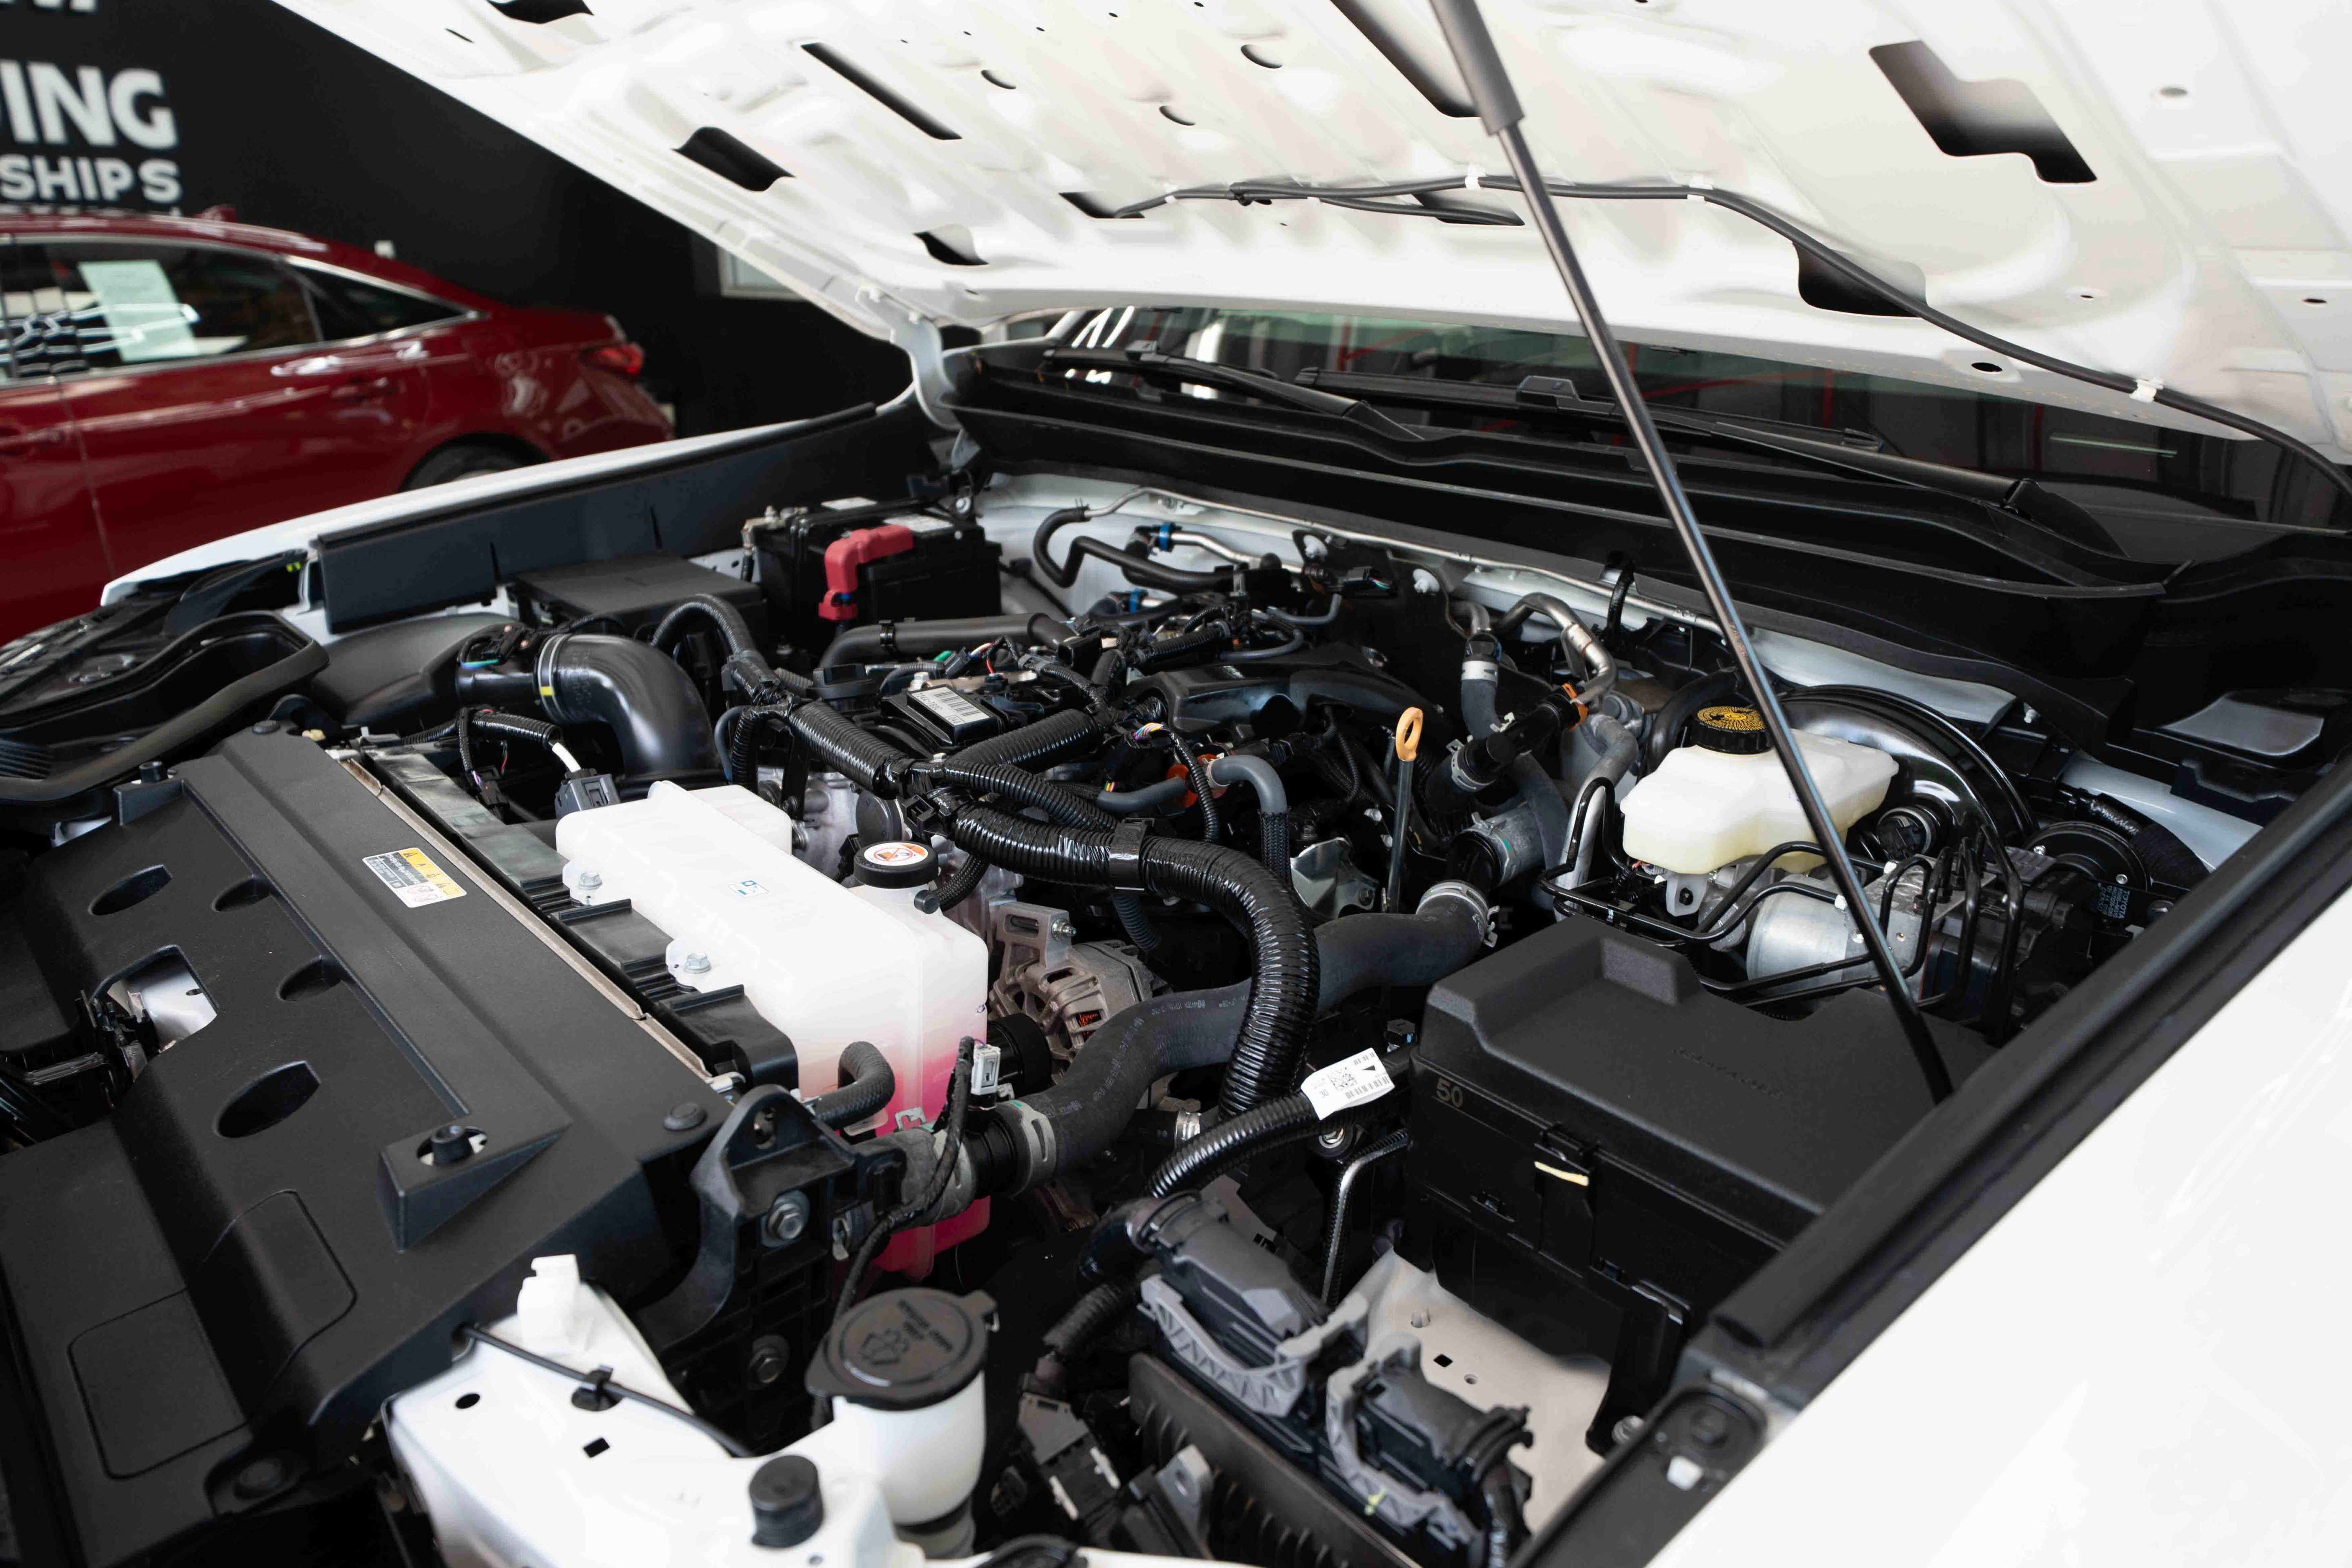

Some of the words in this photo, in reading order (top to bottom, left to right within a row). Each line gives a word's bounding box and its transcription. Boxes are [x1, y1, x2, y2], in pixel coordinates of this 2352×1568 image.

[0, 59, 178, 149] ING
[0, 154, 182, 203] SHIPS
[2118, 891, 2130, 918] TOYOTA
[1437, 1078, 1463, 1107] 50
